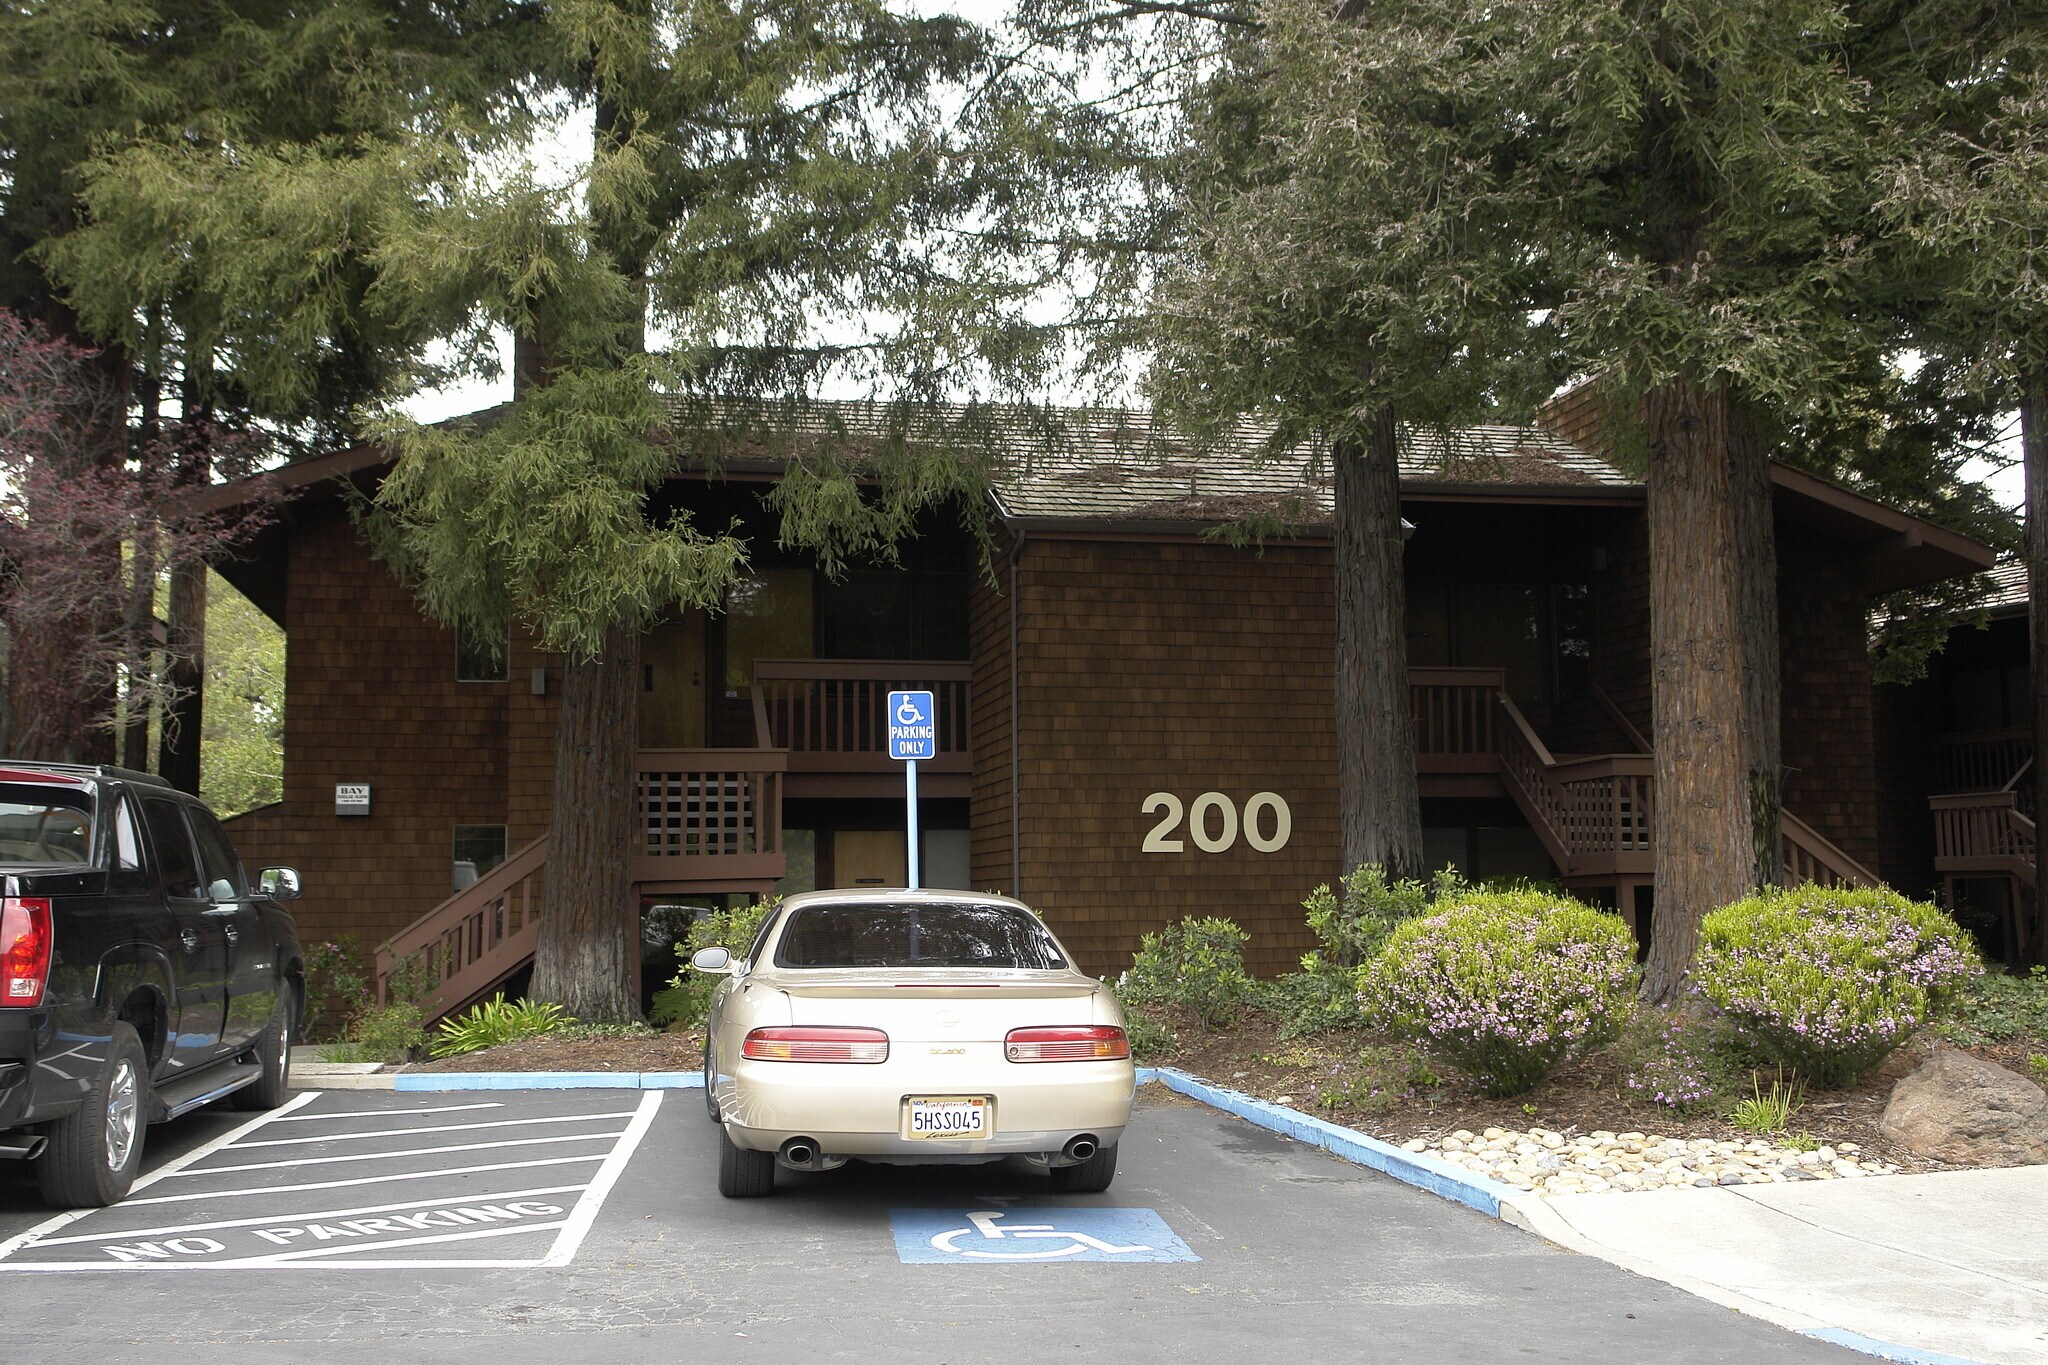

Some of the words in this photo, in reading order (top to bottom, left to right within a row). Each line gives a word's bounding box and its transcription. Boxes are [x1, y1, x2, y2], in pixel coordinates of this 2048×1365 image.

[891, 726, 932, 739] PARKING
[899, 741, 925, 754] ONLY
[1141, 791, 1292, 853] 200
[926, 1101, 971, 1110] California
[914, 1111, 980, 1130] 5HSS045
[100, 1237, 226, 1262] NO
[251, 1201, 565, 1245] PARKING
